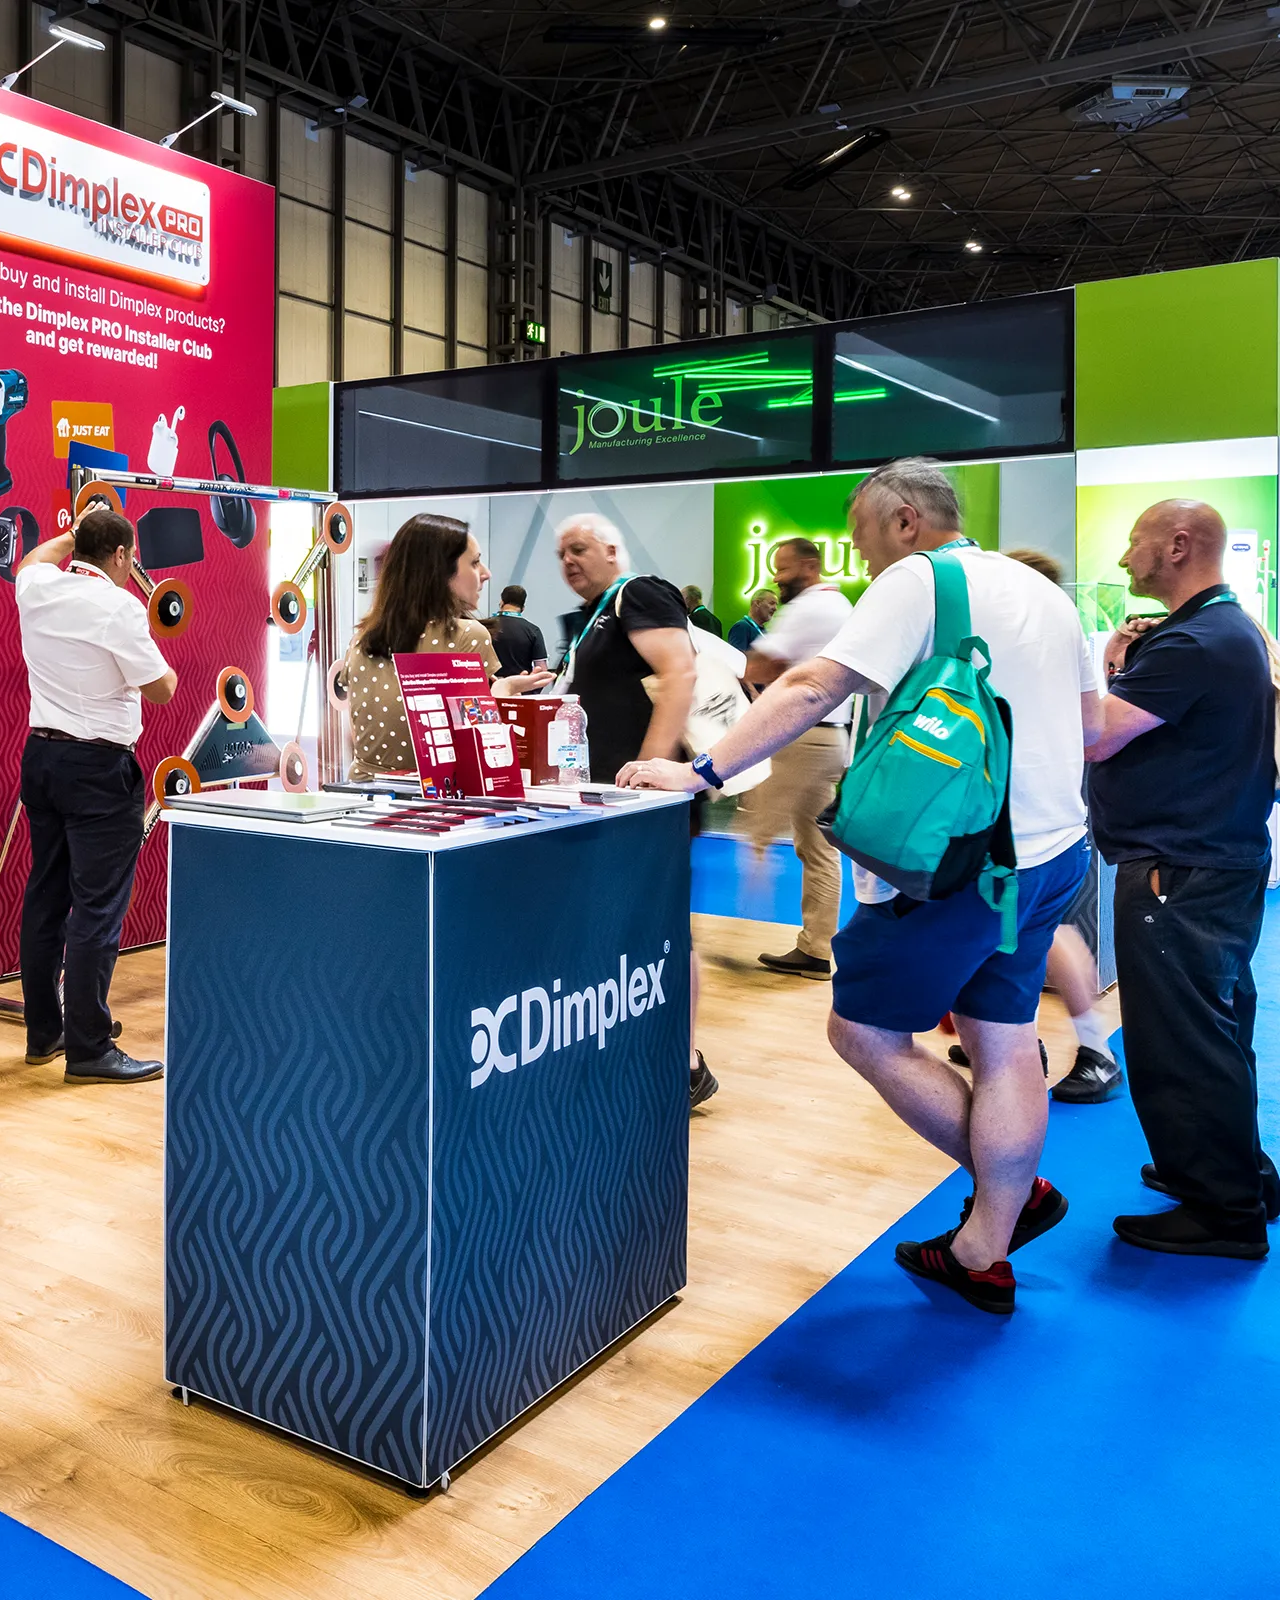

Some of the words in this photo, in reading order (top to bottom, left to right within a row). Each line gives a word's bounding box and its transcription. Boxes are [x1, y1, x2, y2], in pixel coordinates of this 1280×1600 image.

[22, 147, 157, 229] Dimplex
[165, 210, 201, 237] PRO
[98, 217, 167, 248] INSTALLER
[171, 240, 203, 260] CLUB
[0, 261, 28, 289] buy
[33, 274, 60, 293] and
[65, 277, 106, 305] install
[110, 289, 162, 318] Dimplex
[165, 307, 226, 334] products?
[25, 329, 56, 349] and
[58, 336, 84, 359] get
[86, 341, 158, 370] rewarded!
[26, 301, 88, 332] Dimplex
[92, 316, 122, 340] PRO
[125, 324, 181, 353] Installer
[183, 338, 213, 360] Club
[72, 425, 93, 437] JUST
[94, 426, 111, 437] EAT
[569, 375, 723, 456] joule
[588, 436, 653, 449] Manufacturing
[655, 432, 706, 444] Excellence
[912, 714, 949, 740] wilo
[521, 953, 666, 1066] Dimplex
